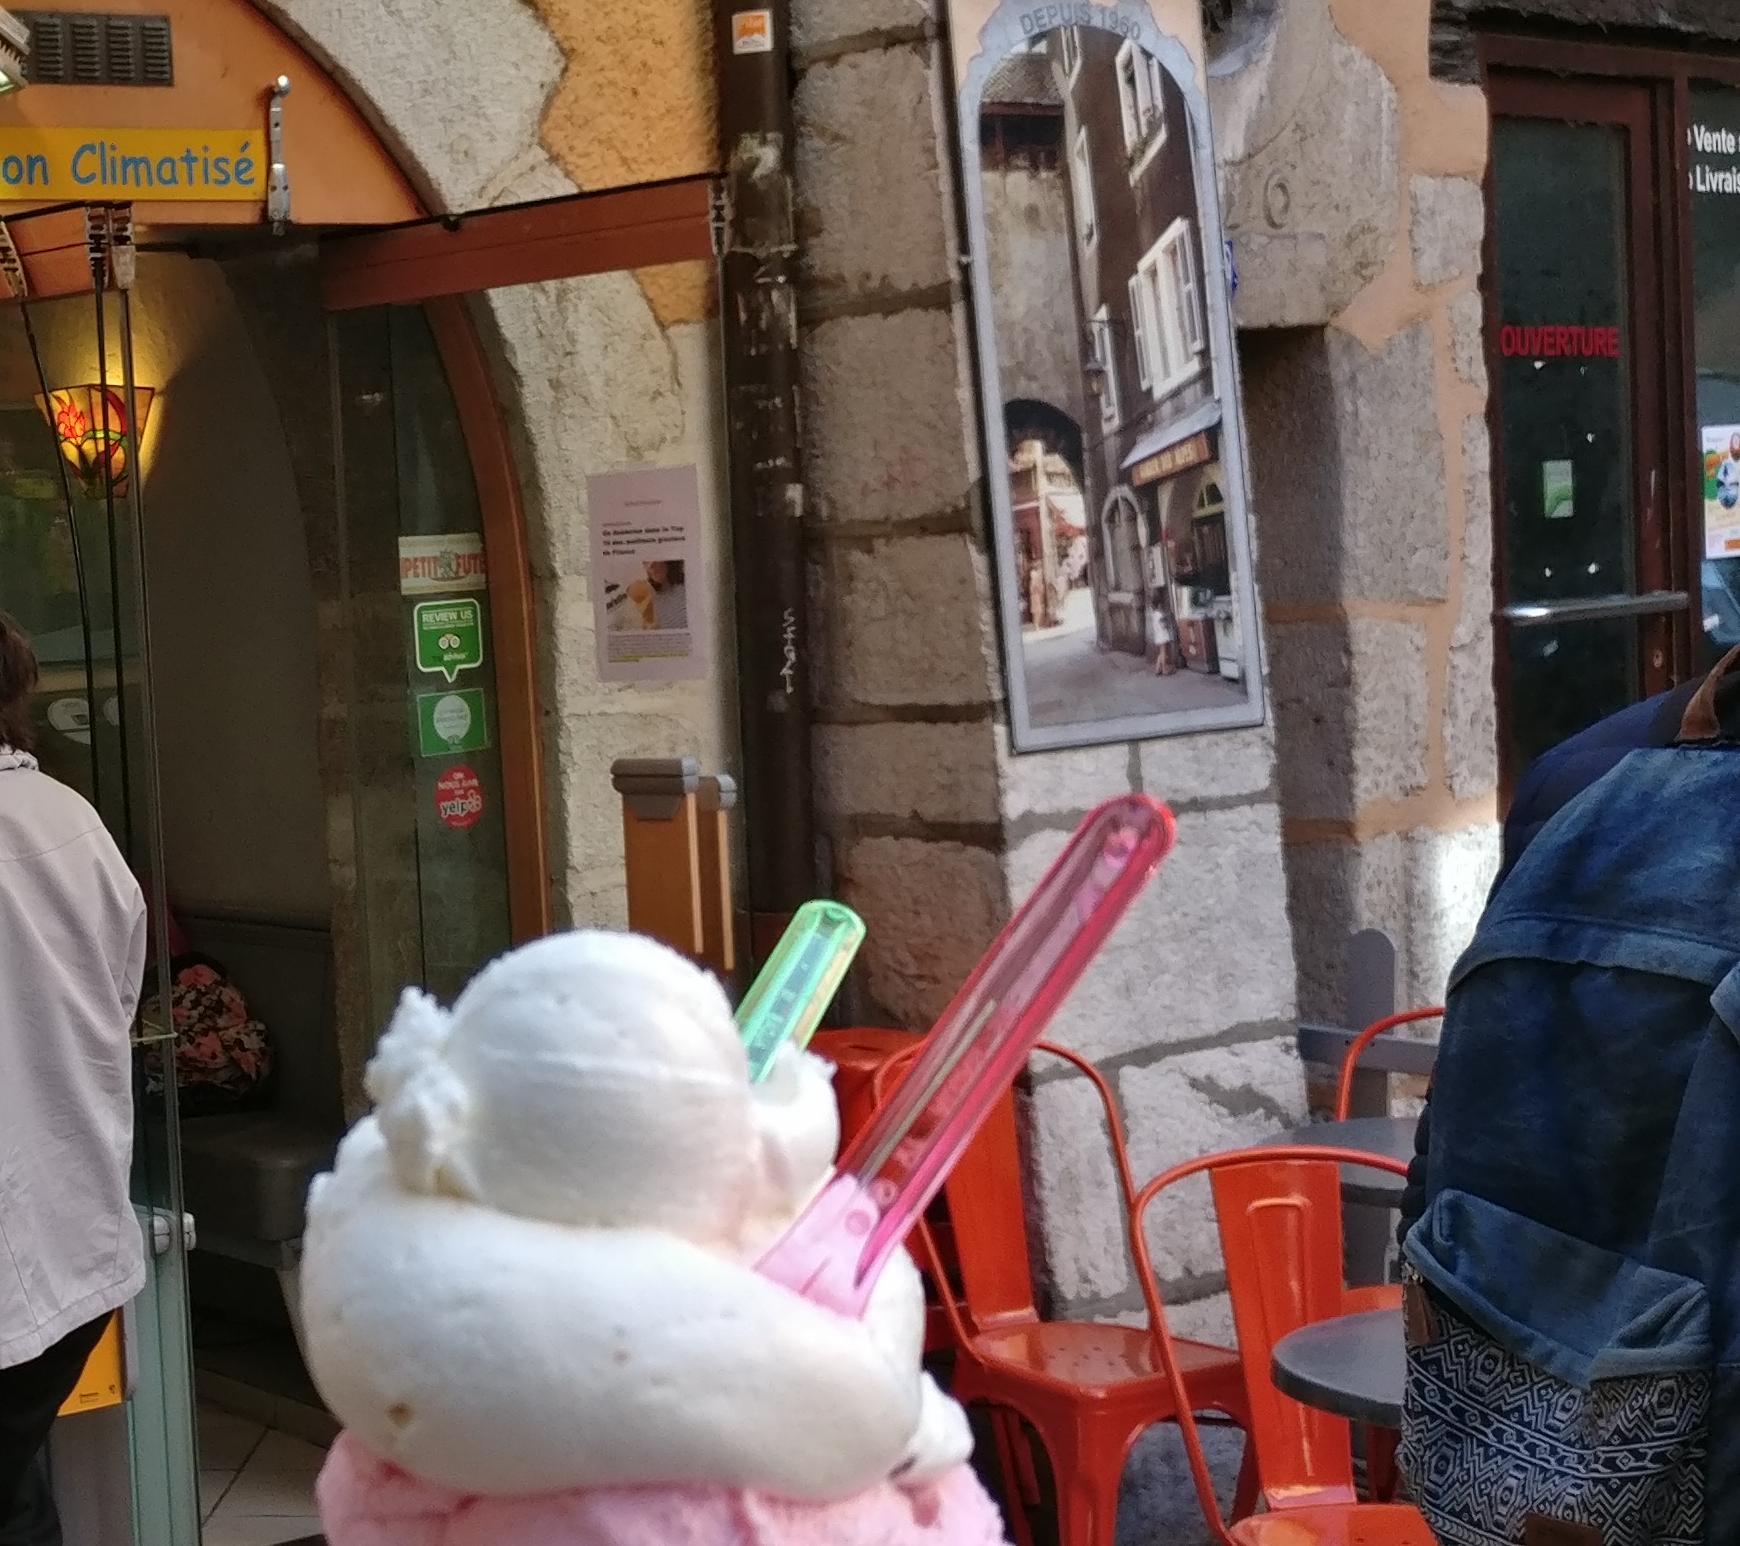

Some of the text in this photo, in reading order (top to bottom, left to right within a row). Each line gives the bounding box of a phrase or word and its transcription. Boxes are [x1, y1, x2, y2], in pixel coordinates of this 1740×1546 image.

[1693, 124, 1736, 155] Vente
[70, 139, 256, 189] Climatisé
[1499, 324, 1620, 357] OUVERTURE
[422, 609, 474, 624] REVIEW US
[441, 799, 468, 817] yelp
